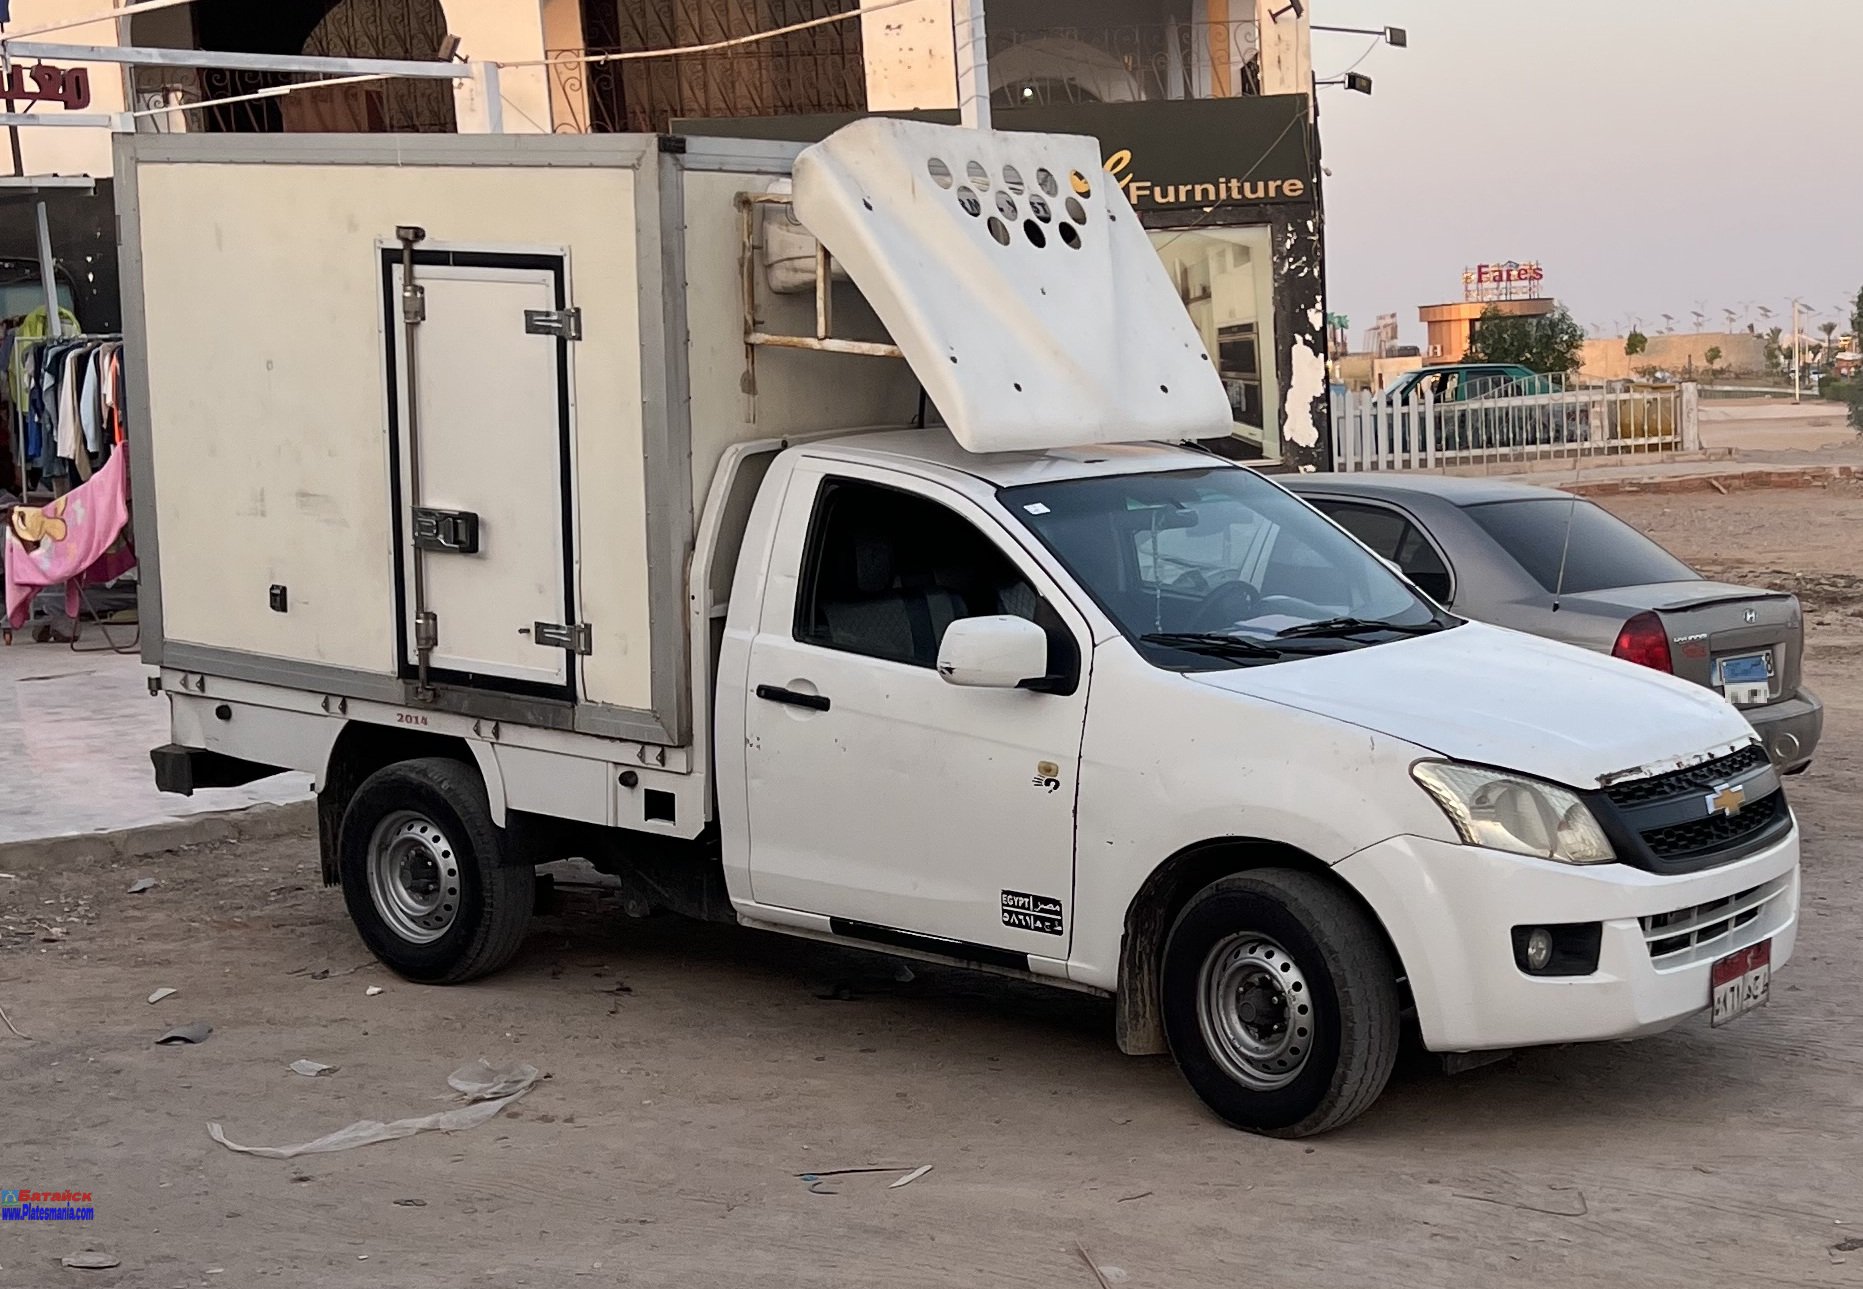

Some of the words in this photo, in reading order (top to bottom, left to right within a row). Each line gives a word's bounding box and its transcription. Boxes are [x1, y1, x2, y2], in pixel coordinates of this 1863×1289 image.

[1129, 177, 1305, 205] Furniture
[396, 712, 428, 726] 2014
[1002, 894, 1030, 908] EGYPT
[1034, 901, 1061, 912] مصر
